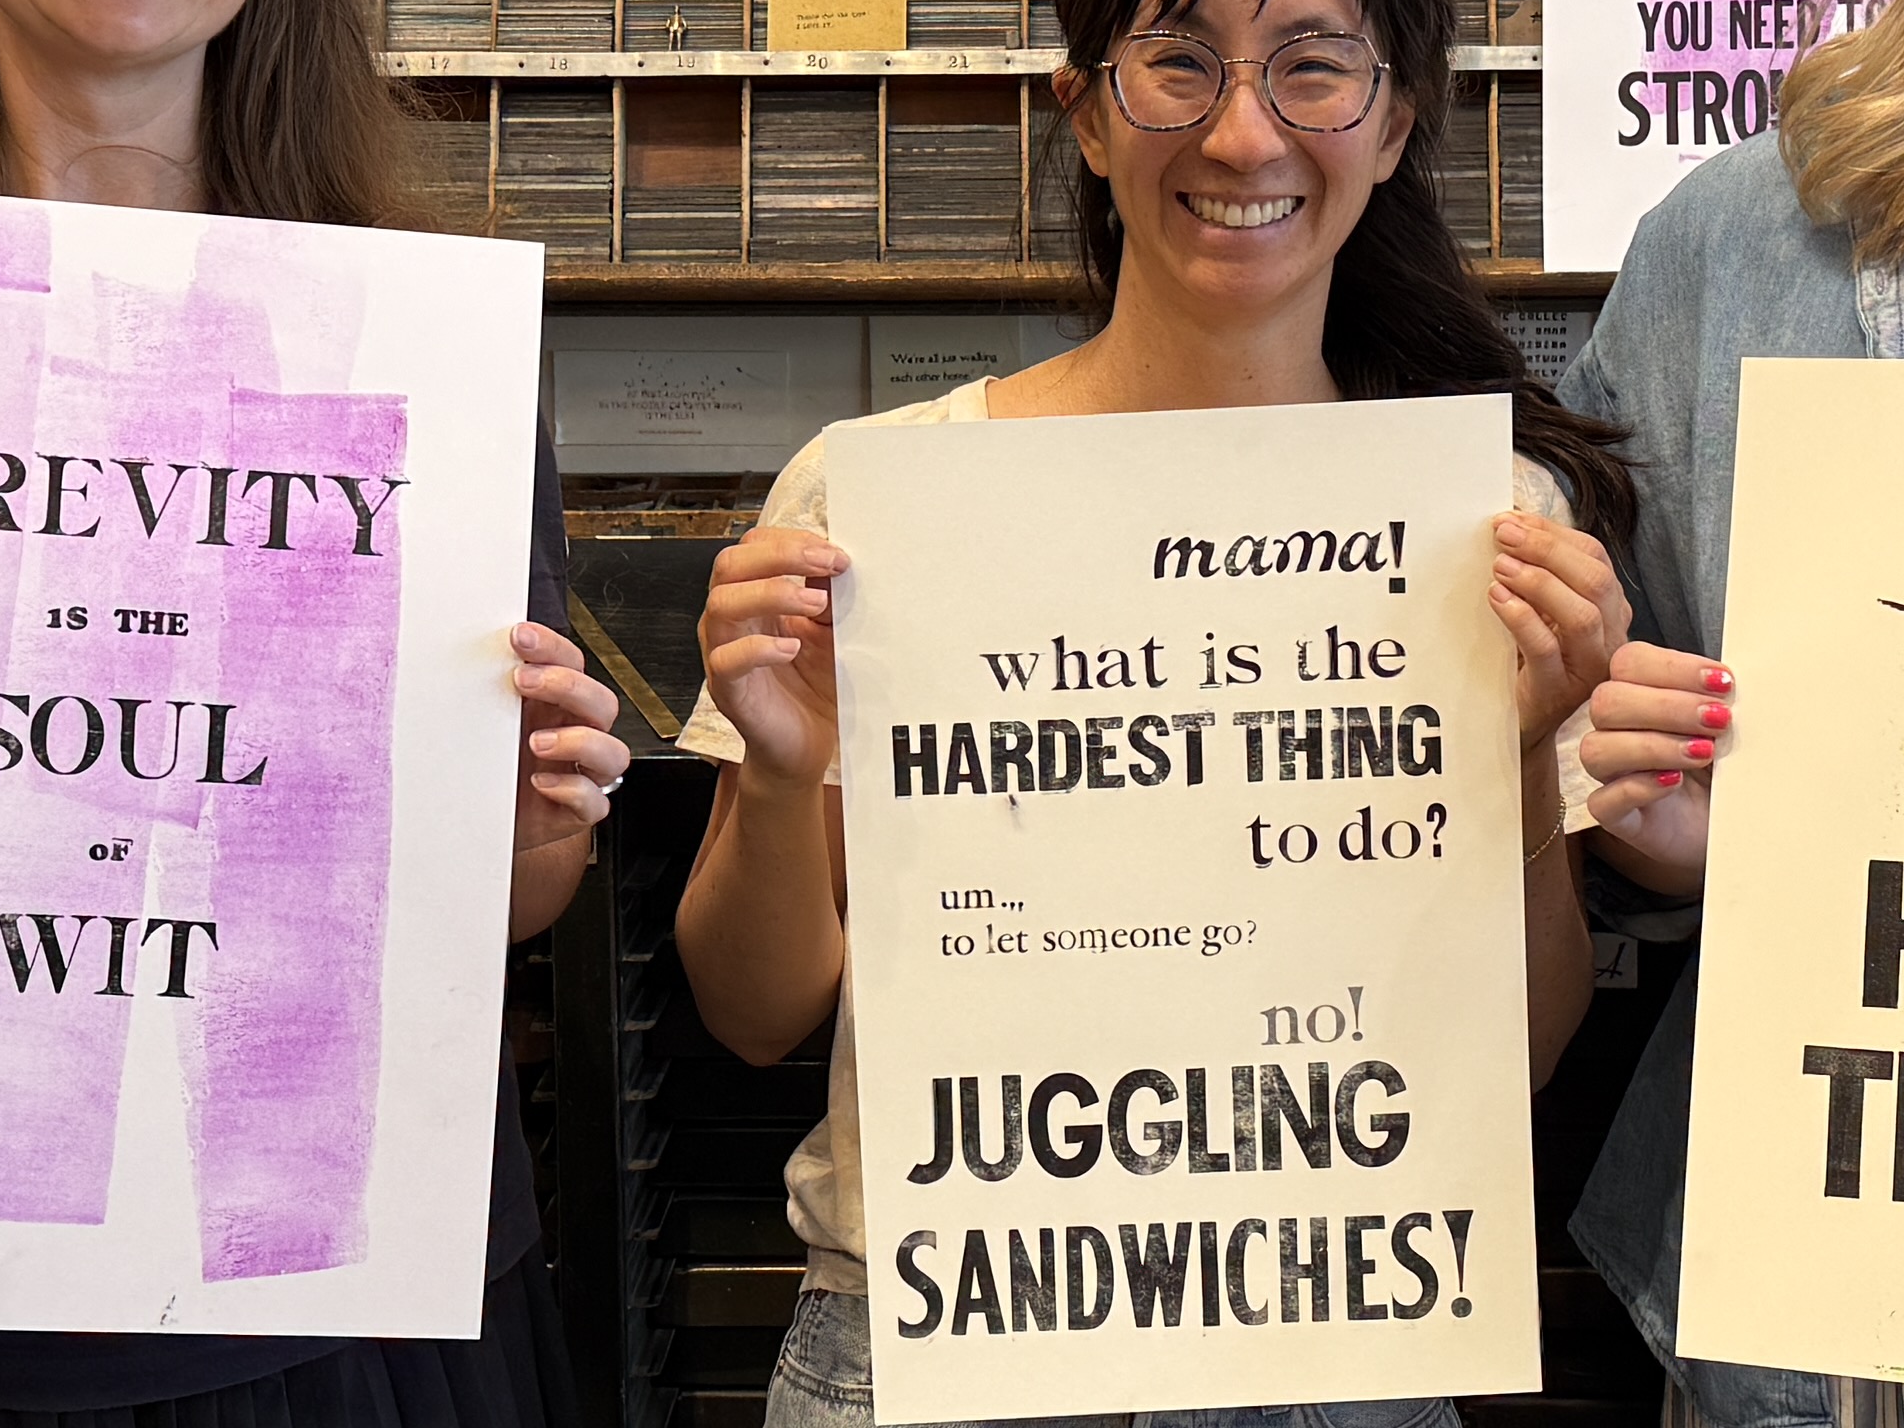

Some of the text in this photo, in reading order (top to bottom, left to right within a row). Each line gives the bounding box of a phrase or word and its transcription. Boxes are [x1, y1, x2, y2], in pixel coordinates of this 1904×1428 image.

[1153, 520, 1407, 595] mama!
[114, 608, 188, 636] THE
[980, 625, 1407, 693] what is the
[892, 704, 1442, 798] HARDEST THING
[1245, 802, 1447, 870] to do?
[942, 920, 1257, 956] to let someone go?
[1259, 986, 1364, 1048] no!
[906, 1059, 1411, 1184] JUGGLING
[896, 1209, 1476, 1340] SANDWICHES!
